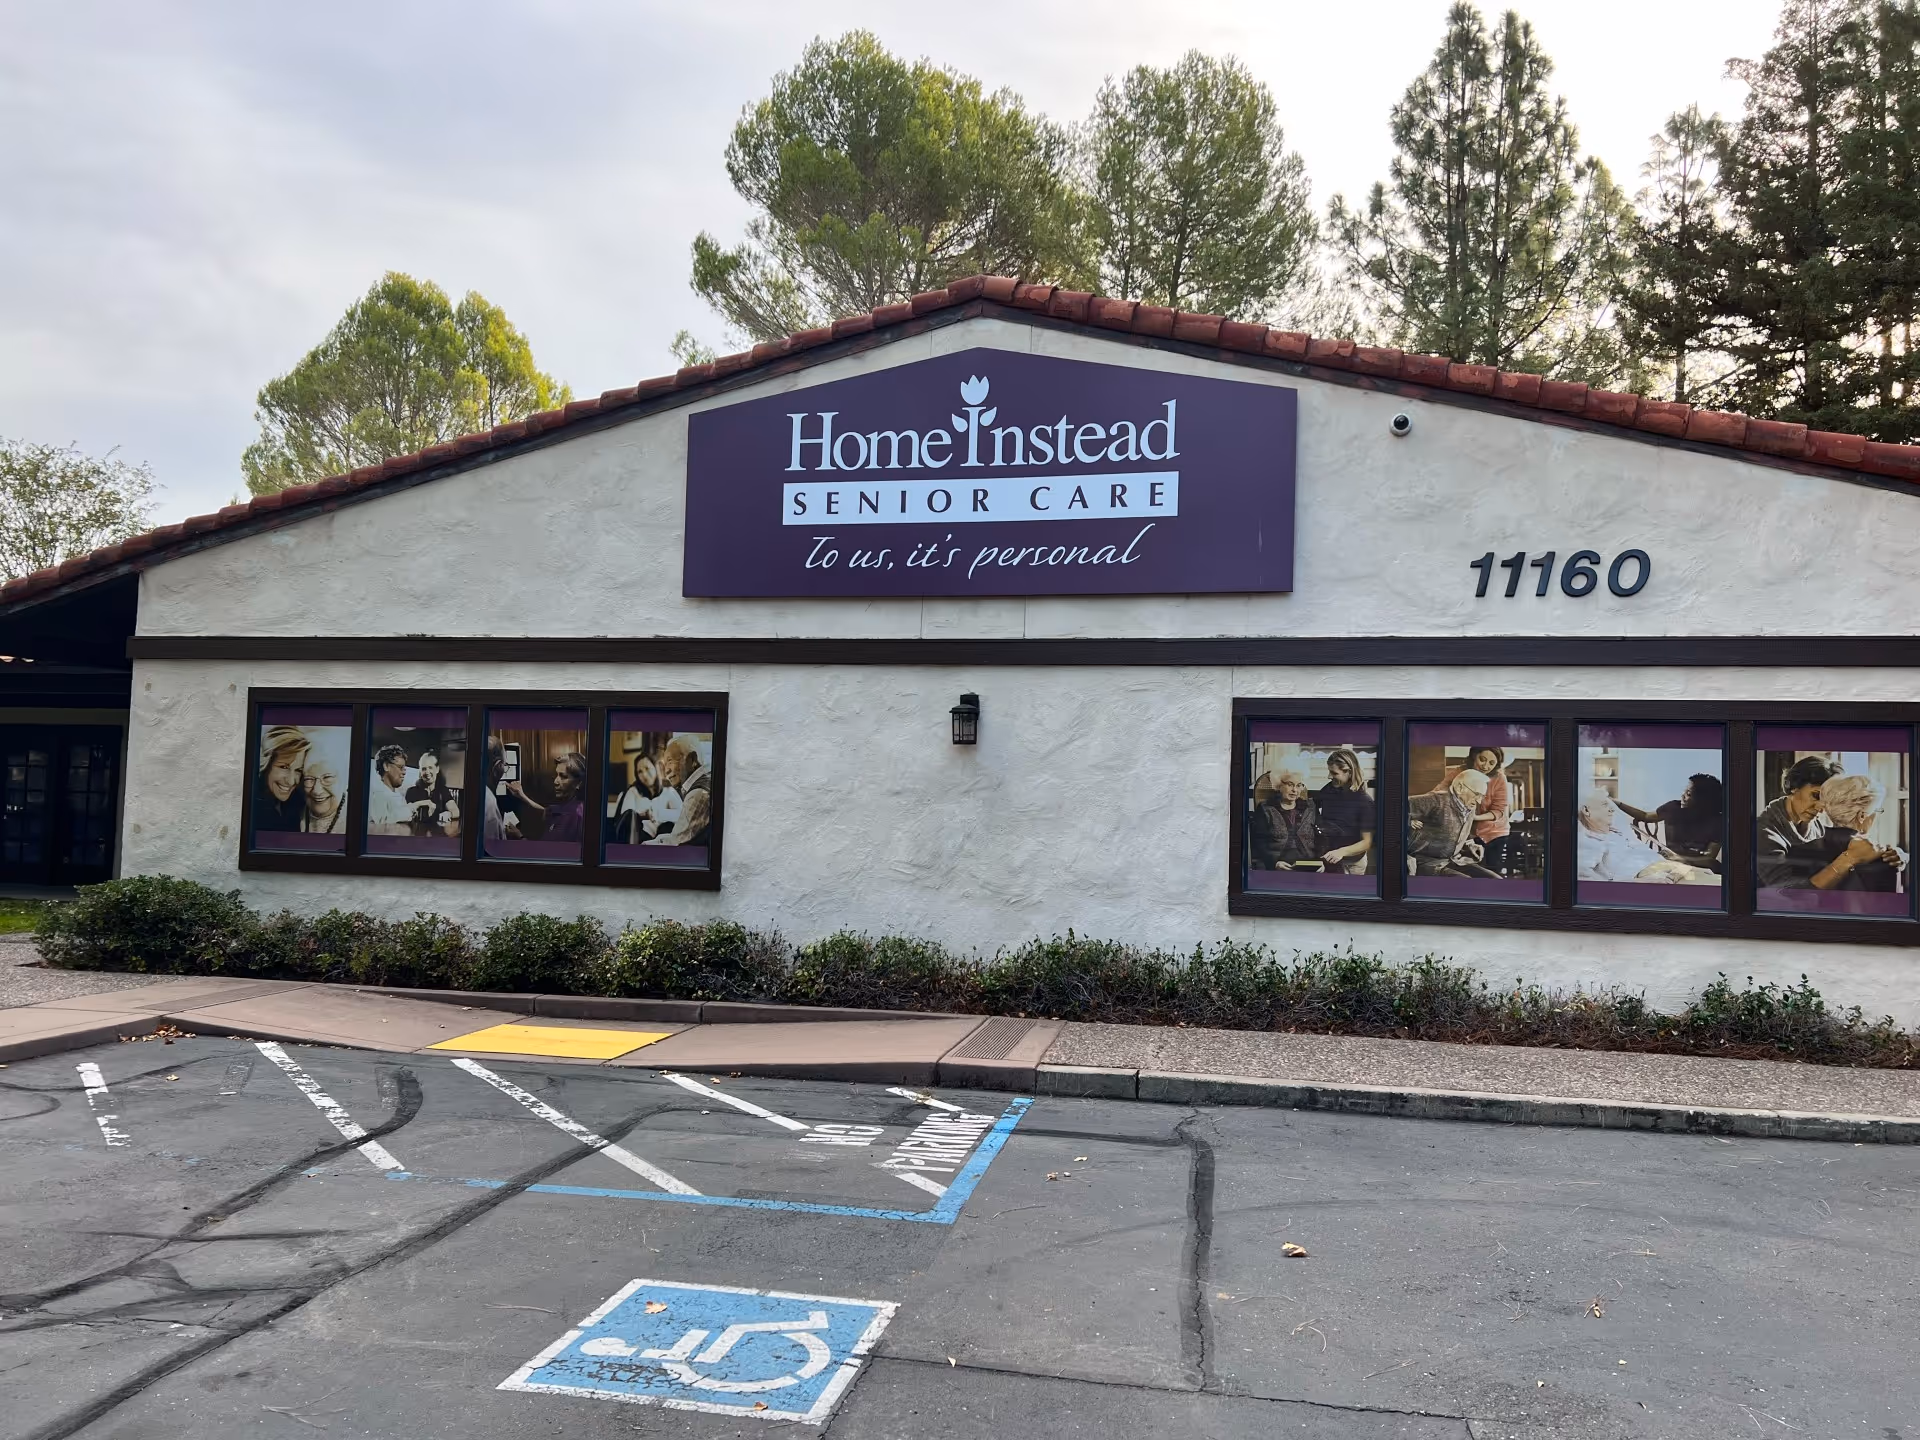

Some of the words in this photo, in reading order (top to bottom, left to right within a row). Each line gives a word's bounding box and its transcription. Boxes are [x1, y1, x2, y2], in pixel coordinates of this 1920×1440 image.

[784, 411, 953, 471] Home
[958, 399, 1181, 467] Instead
[792, 488, 991, 516] SENIOR
[1029, 483, 1165, 511] CARE
[804, 536, 840, 569] To
[848, 549, 894, 571] us,
[906, 533, 962, 569] it's
[968, 523, 1156, 580] personal
[1469, 549, 1651, 598] 11160
[798, 1124, 885, 1147] NO
[882, 1112, 997, 1173] PARKING
